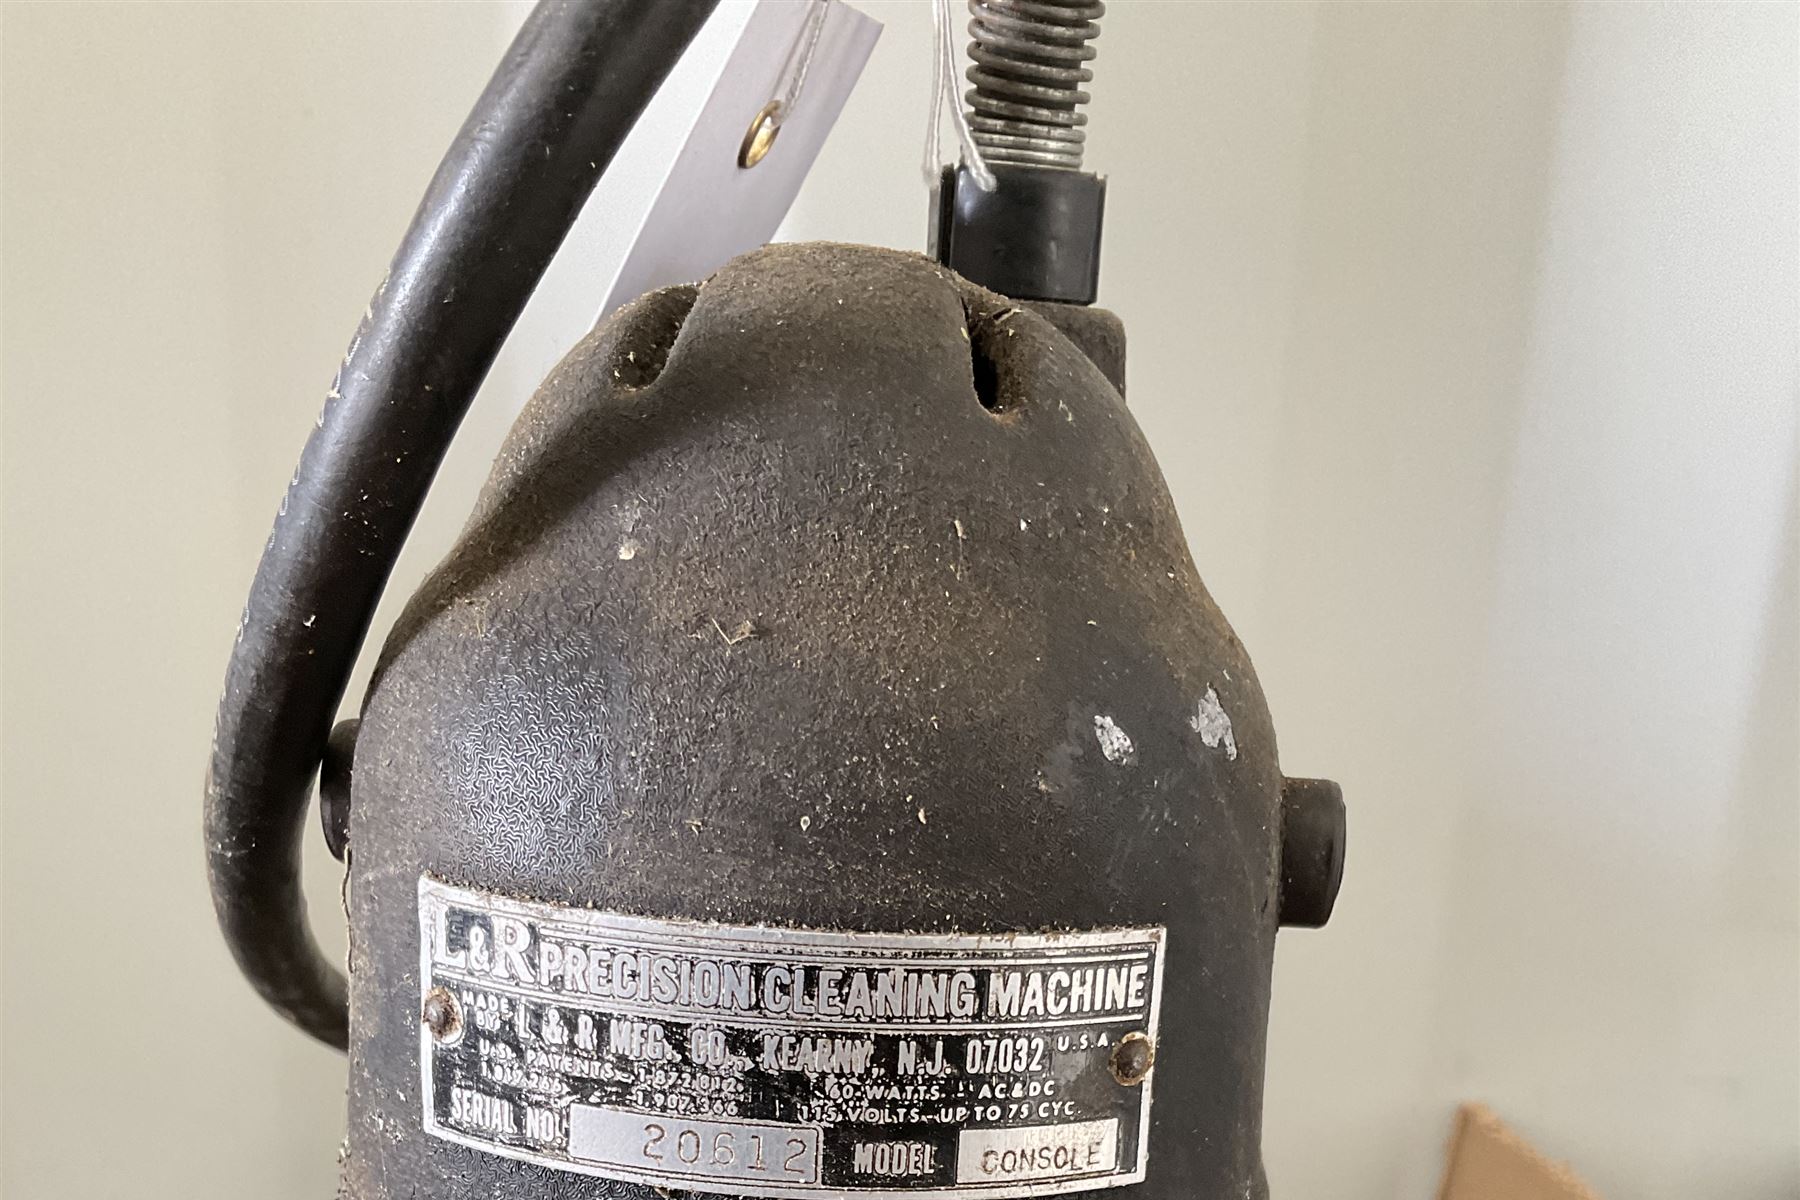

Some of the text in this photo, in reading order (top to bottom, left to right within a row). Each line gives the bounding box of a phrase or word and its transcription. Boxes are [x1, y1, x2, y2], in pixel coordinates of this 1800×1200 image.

[540, 941, 1147, 1017] PRECISION CLEANING MACHINE
[462, 990, 510, 1014] MADE
[475, 1009, 500, 1030] BY
[519, 1003, 531, 1040] L
[577, 1014, 597, 1053] R
[898, 1040, 952, 1076] N.J.
[966, 1038, 1044, 1075] 07032
[1057, 1032, 1116, 1052] U.S.A.
[526, 1049, 614, 1078] PATENTS
[940, 1106, 969, 1122] UP
[974, 1106, 1002, 1121] TO
[1008, 1103, 1030, 1118] 75
[1038, 1101, 1082, 1118] CYC.
[450, 1086, 516, 1134] SERIAL
[643, 1123, 808, 1175] 20612
[853, 1142, 1102, 1175] MODEL CONSOLE
